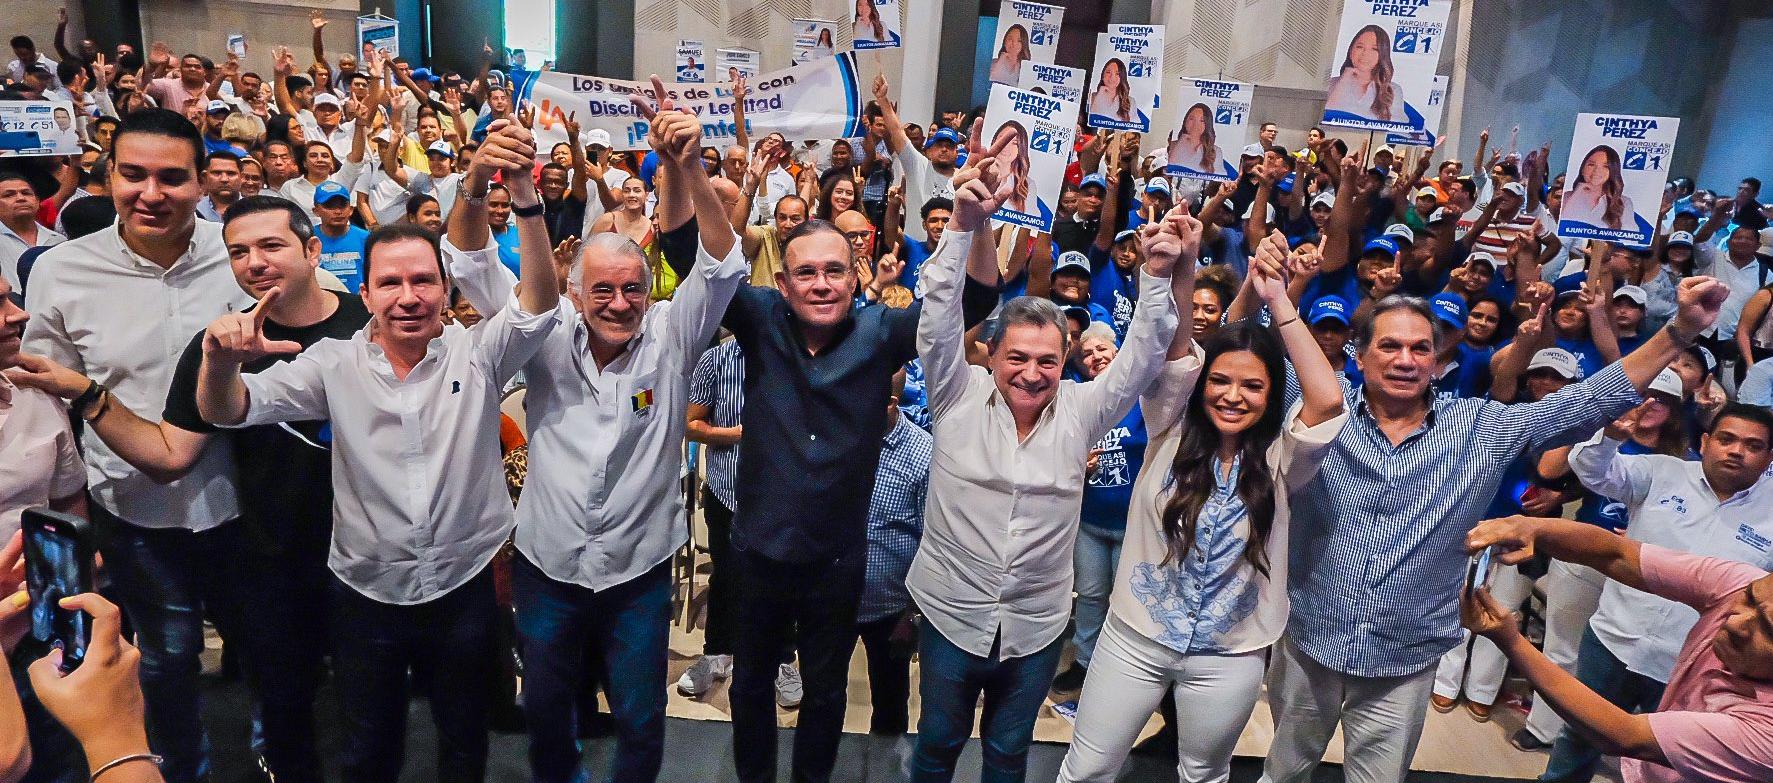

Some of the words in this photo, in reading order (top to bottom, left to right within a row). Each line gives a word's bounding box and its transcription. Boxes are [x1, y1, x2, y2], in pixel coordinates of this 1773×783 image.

[1013, 2, 1051, 14] CINTHYA
[1372, 3, 1418, 17] PEREZ
[1017, 10, 1044, 21] PEREZ
[1119, 26, 1153, 34] CINTHYA
[1397, 26, 1442, 35] CONCEJO
[1047, 35, 1054, 45] 1
[1110, 36, 1149, 48] CINTHYA
[1421, 36, 1431, 53] 1
[1114, 44, 1142, 54] PEREZ
[1032, 64, 1072, 77] CINTHYA
[1145, 66, 1152, 77] 1
[1037, 73, 1065, 84] PEREZ
[573, 77, 604, 93] Los
[683, 88, 709, 99] de
[715, 87, 753, 98] Lus
[758, 75, 795, 91] con
[1194, 80, 1240, 92] CINTHYA
[1200, 88, 1233, 99] PEREZ
[1007, 90, 1062, 113] CINTHYA
[1013, 102, 1053, 121] PEREZ
[14, 121, 25, 130] 12
[41, 120, 54, 130] 51
[1234, 113, 1242, 125] 1
[1595, 117, 1658, 129] CINTHYA
[1035, 119, 1061, 132] MARQUE
[1602, 127, 1647, 139] PEREZ
[1053, 140, 1062, 154] 1
[1650, 155, 1661, 170] 1
[1005, 211, 1045, 227] AVANZAMOS
[1599, 229, 1645, 240] AVANZAMOS
[1435, 299, 1460, 311] CINTHYA
[1113, 451, 1126, 459] ASI
[1108, 467, 1122, 484] 1
